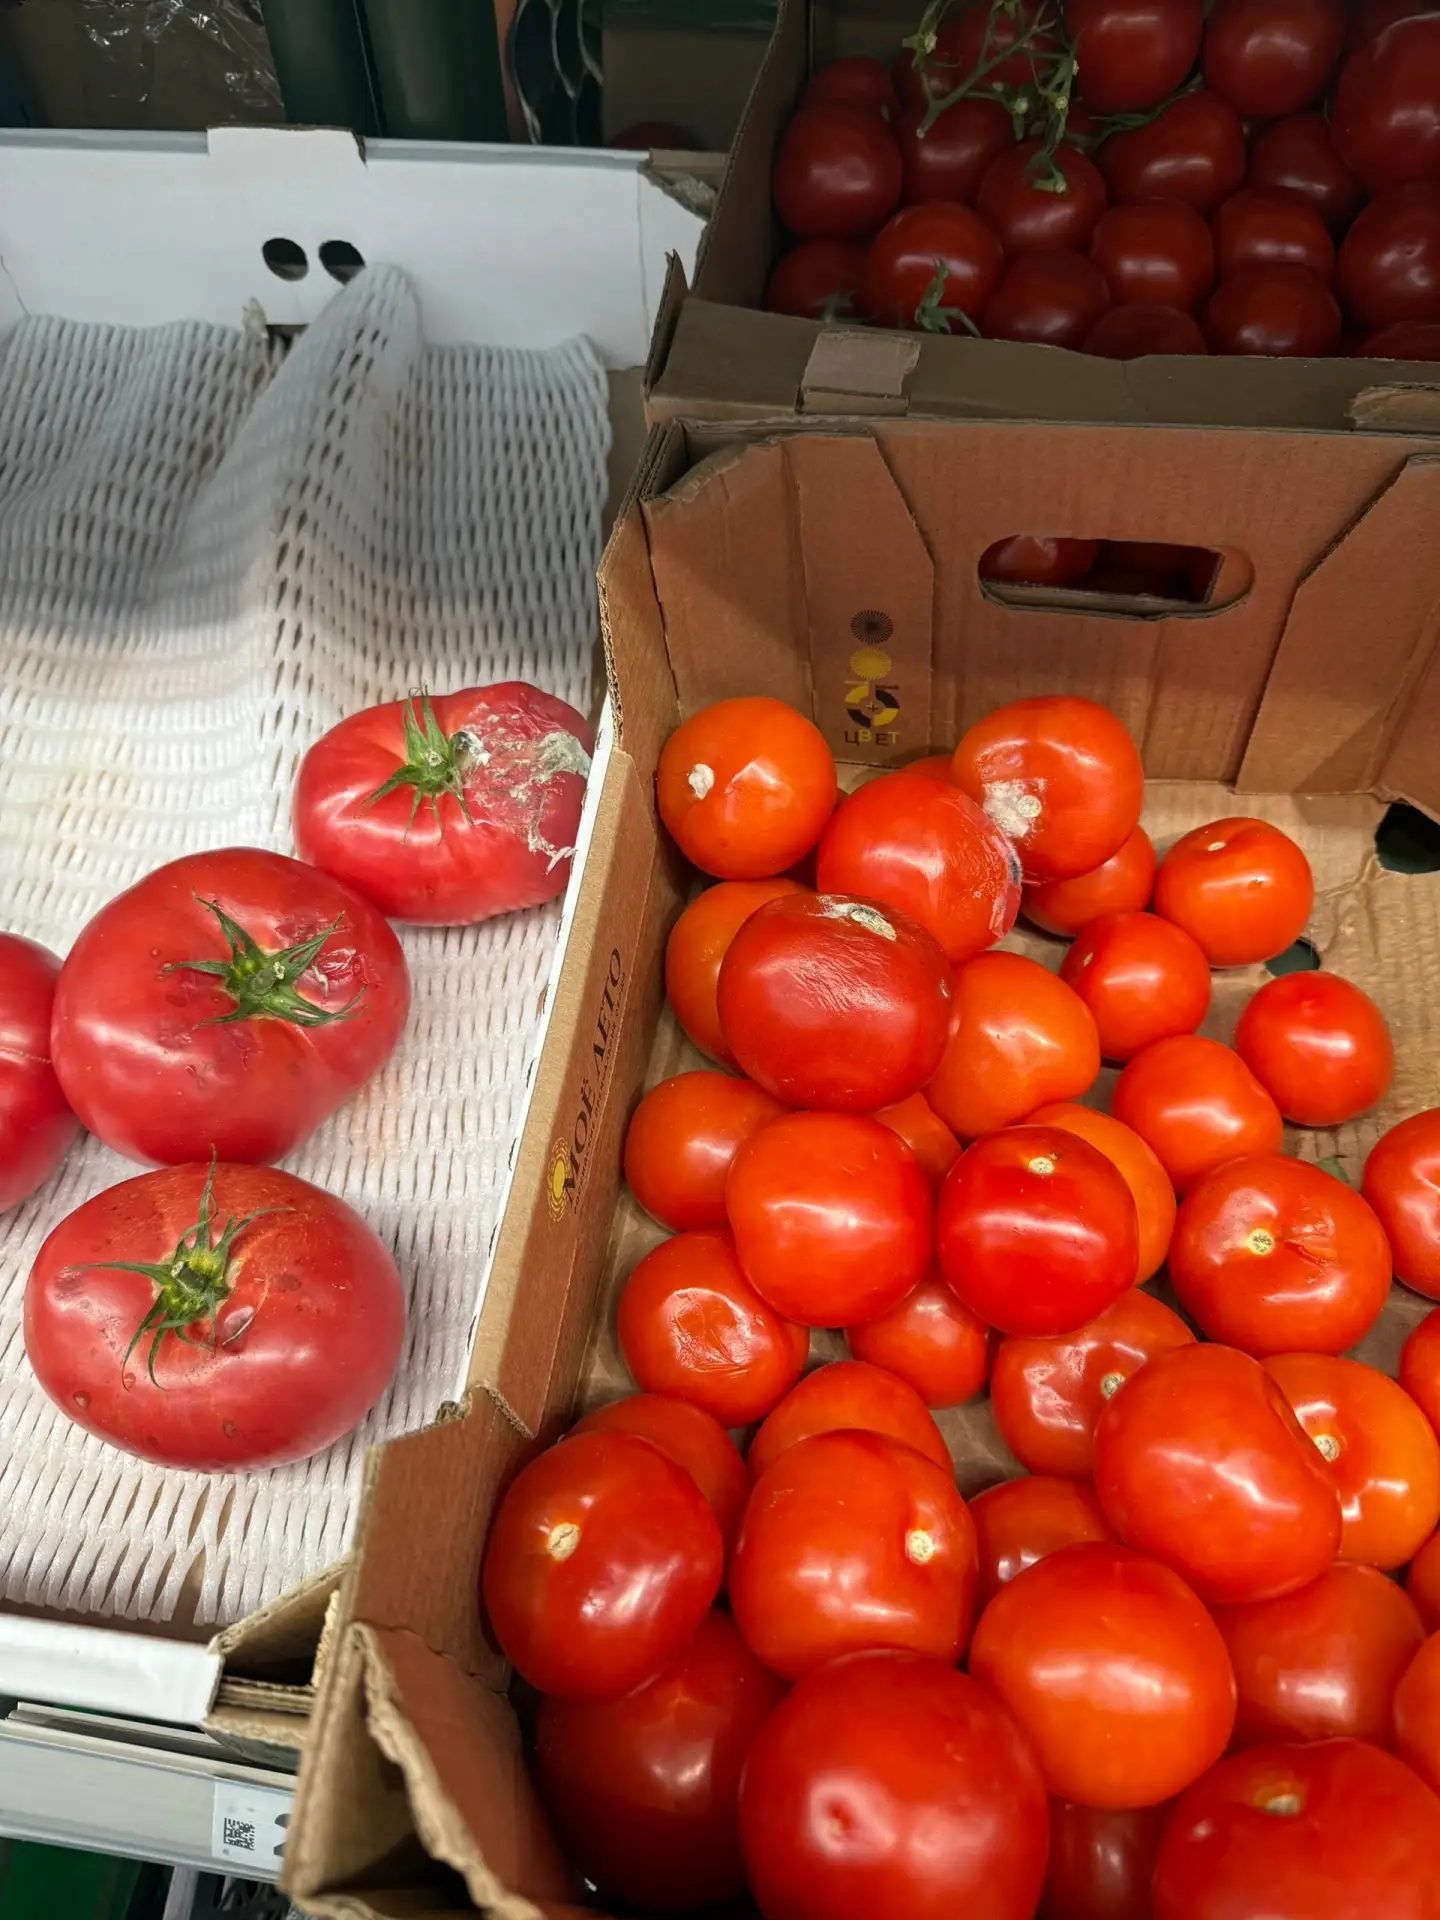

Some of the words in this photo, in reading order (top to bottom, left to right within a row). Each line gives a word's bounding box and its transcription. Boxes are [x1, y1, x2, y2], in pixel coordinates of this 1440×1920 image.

[844, 728, 900, 746] ЦВЕТ
[563, 1077, 595, 1206] МОЁ
[592, 948, 621, 1078] ЛЕТО
